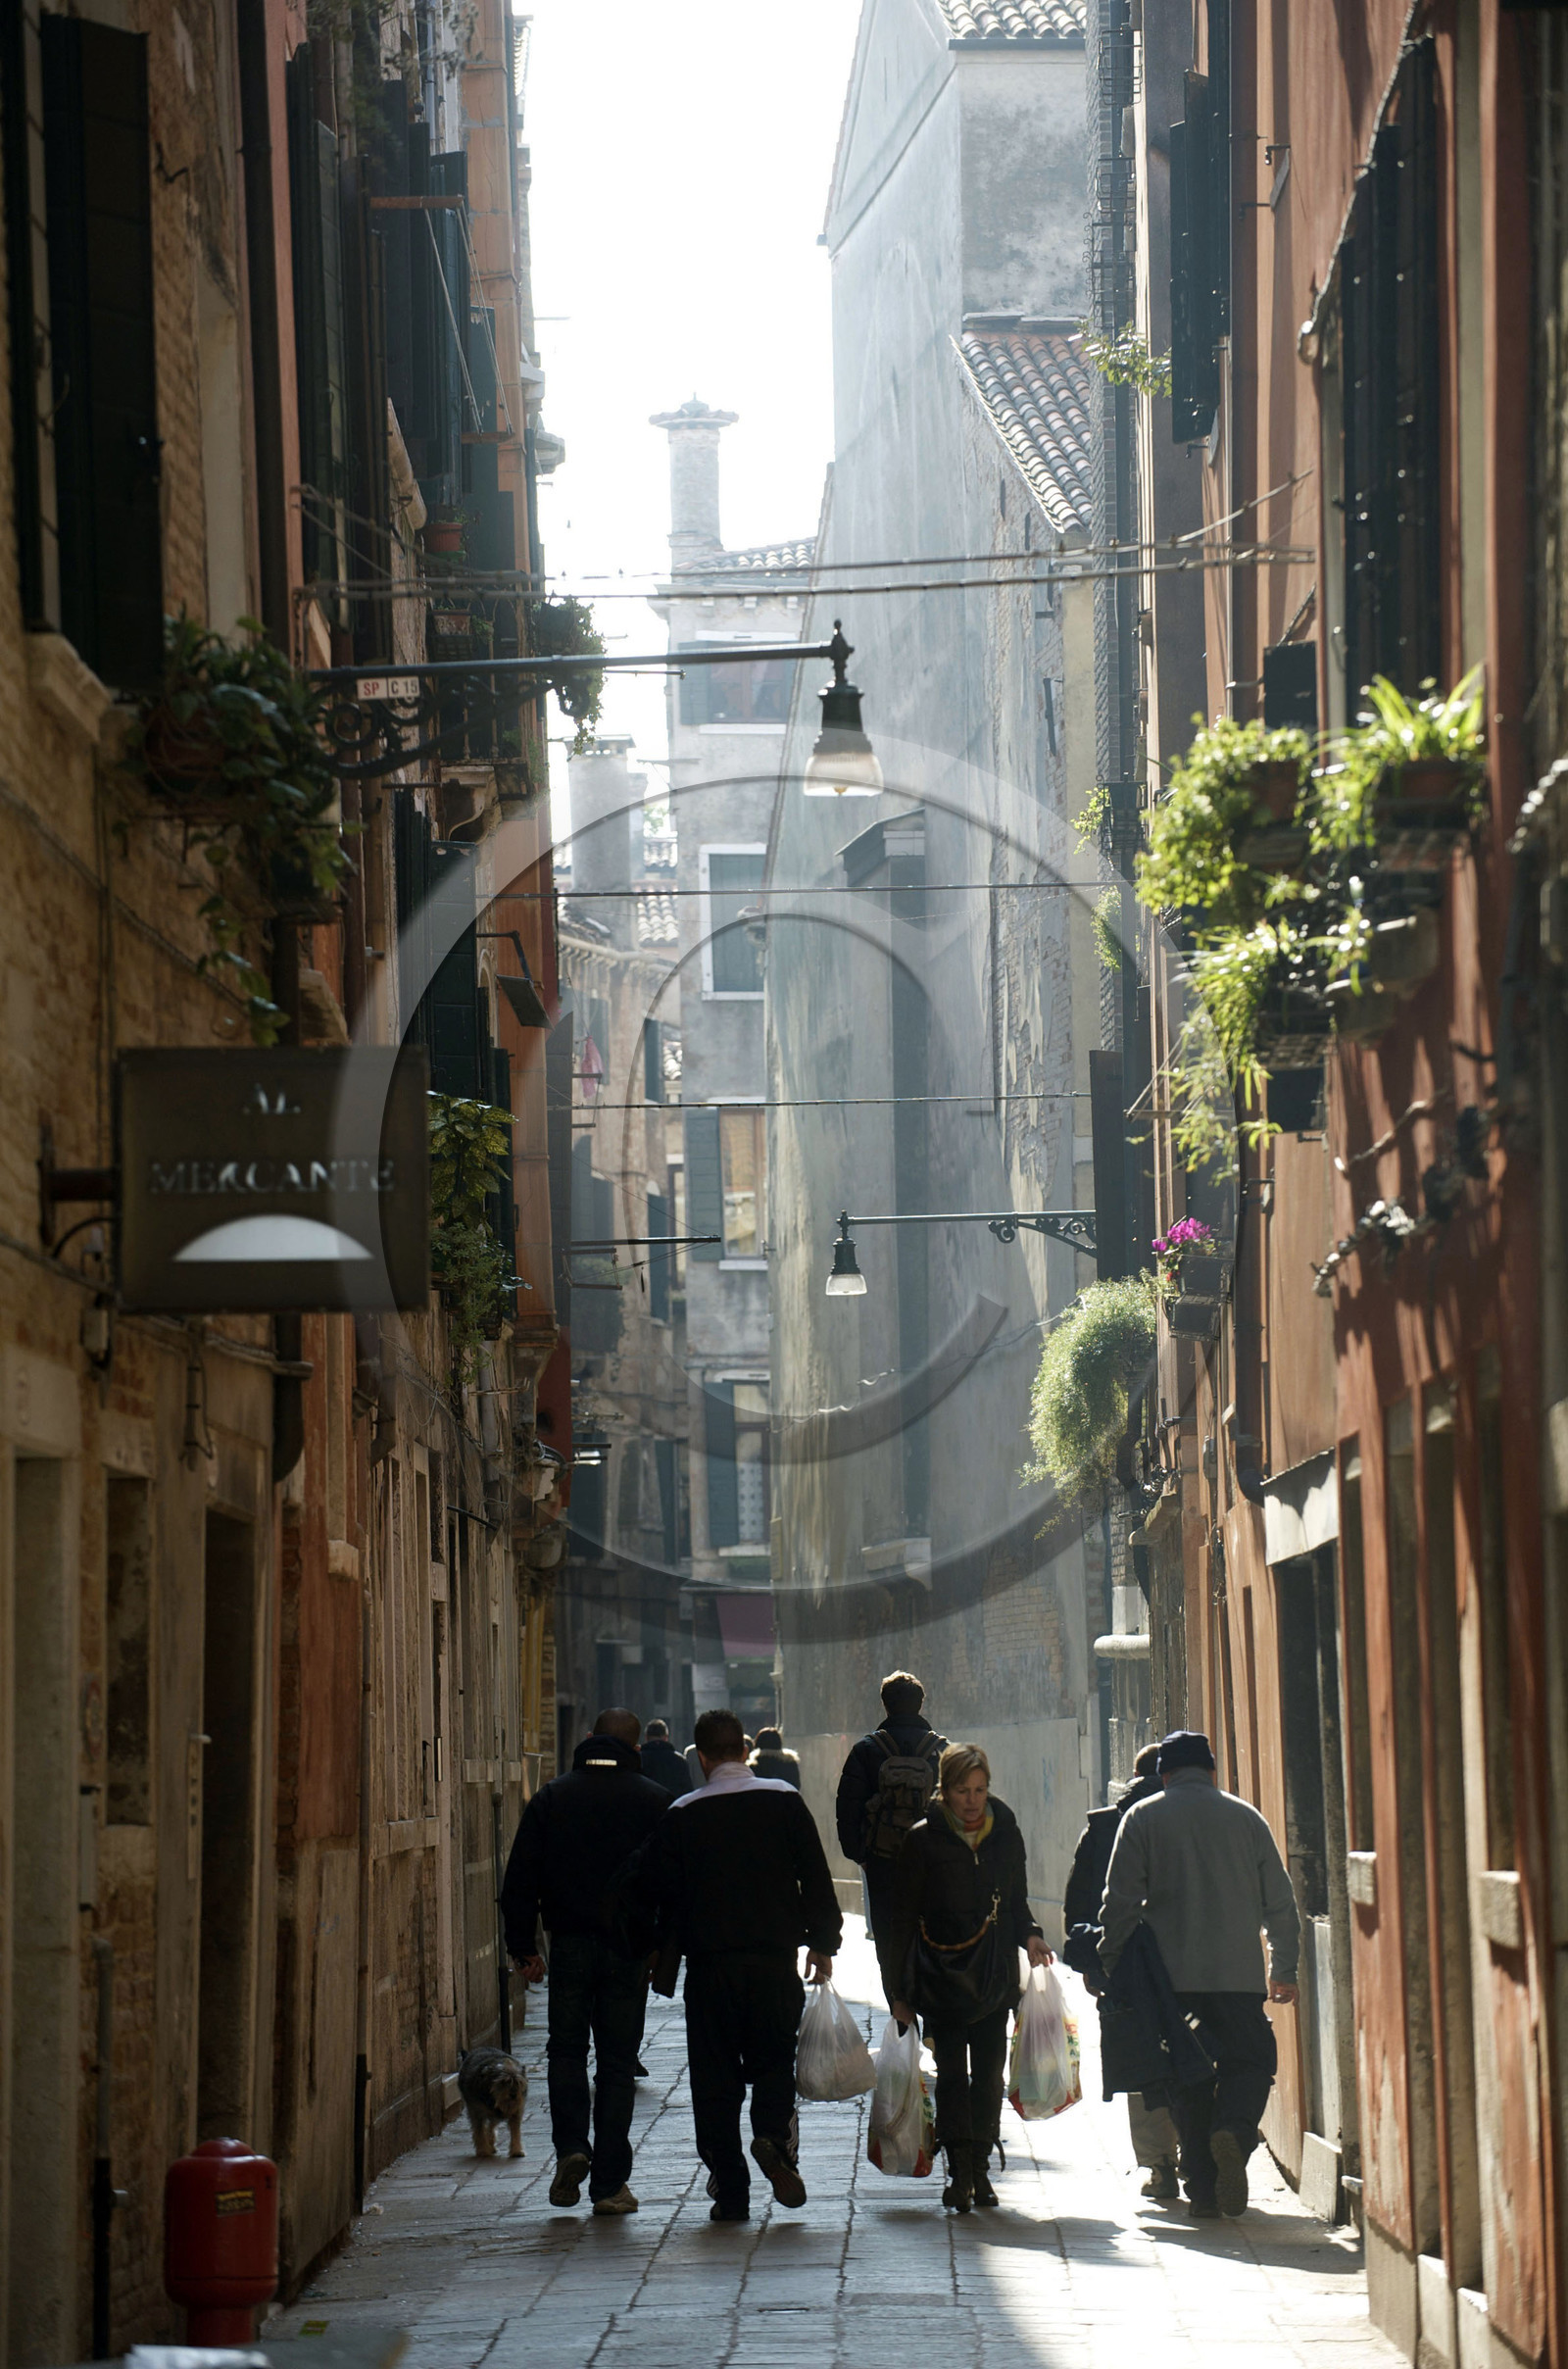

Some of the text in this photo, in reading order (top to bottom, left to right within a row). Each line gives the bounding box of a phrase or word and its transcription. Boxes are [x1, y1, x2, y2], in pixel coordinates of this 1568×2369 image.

[364, 680, 417, 695] SP C 15
[150, 1160, 394, 1194] MERCANTE
